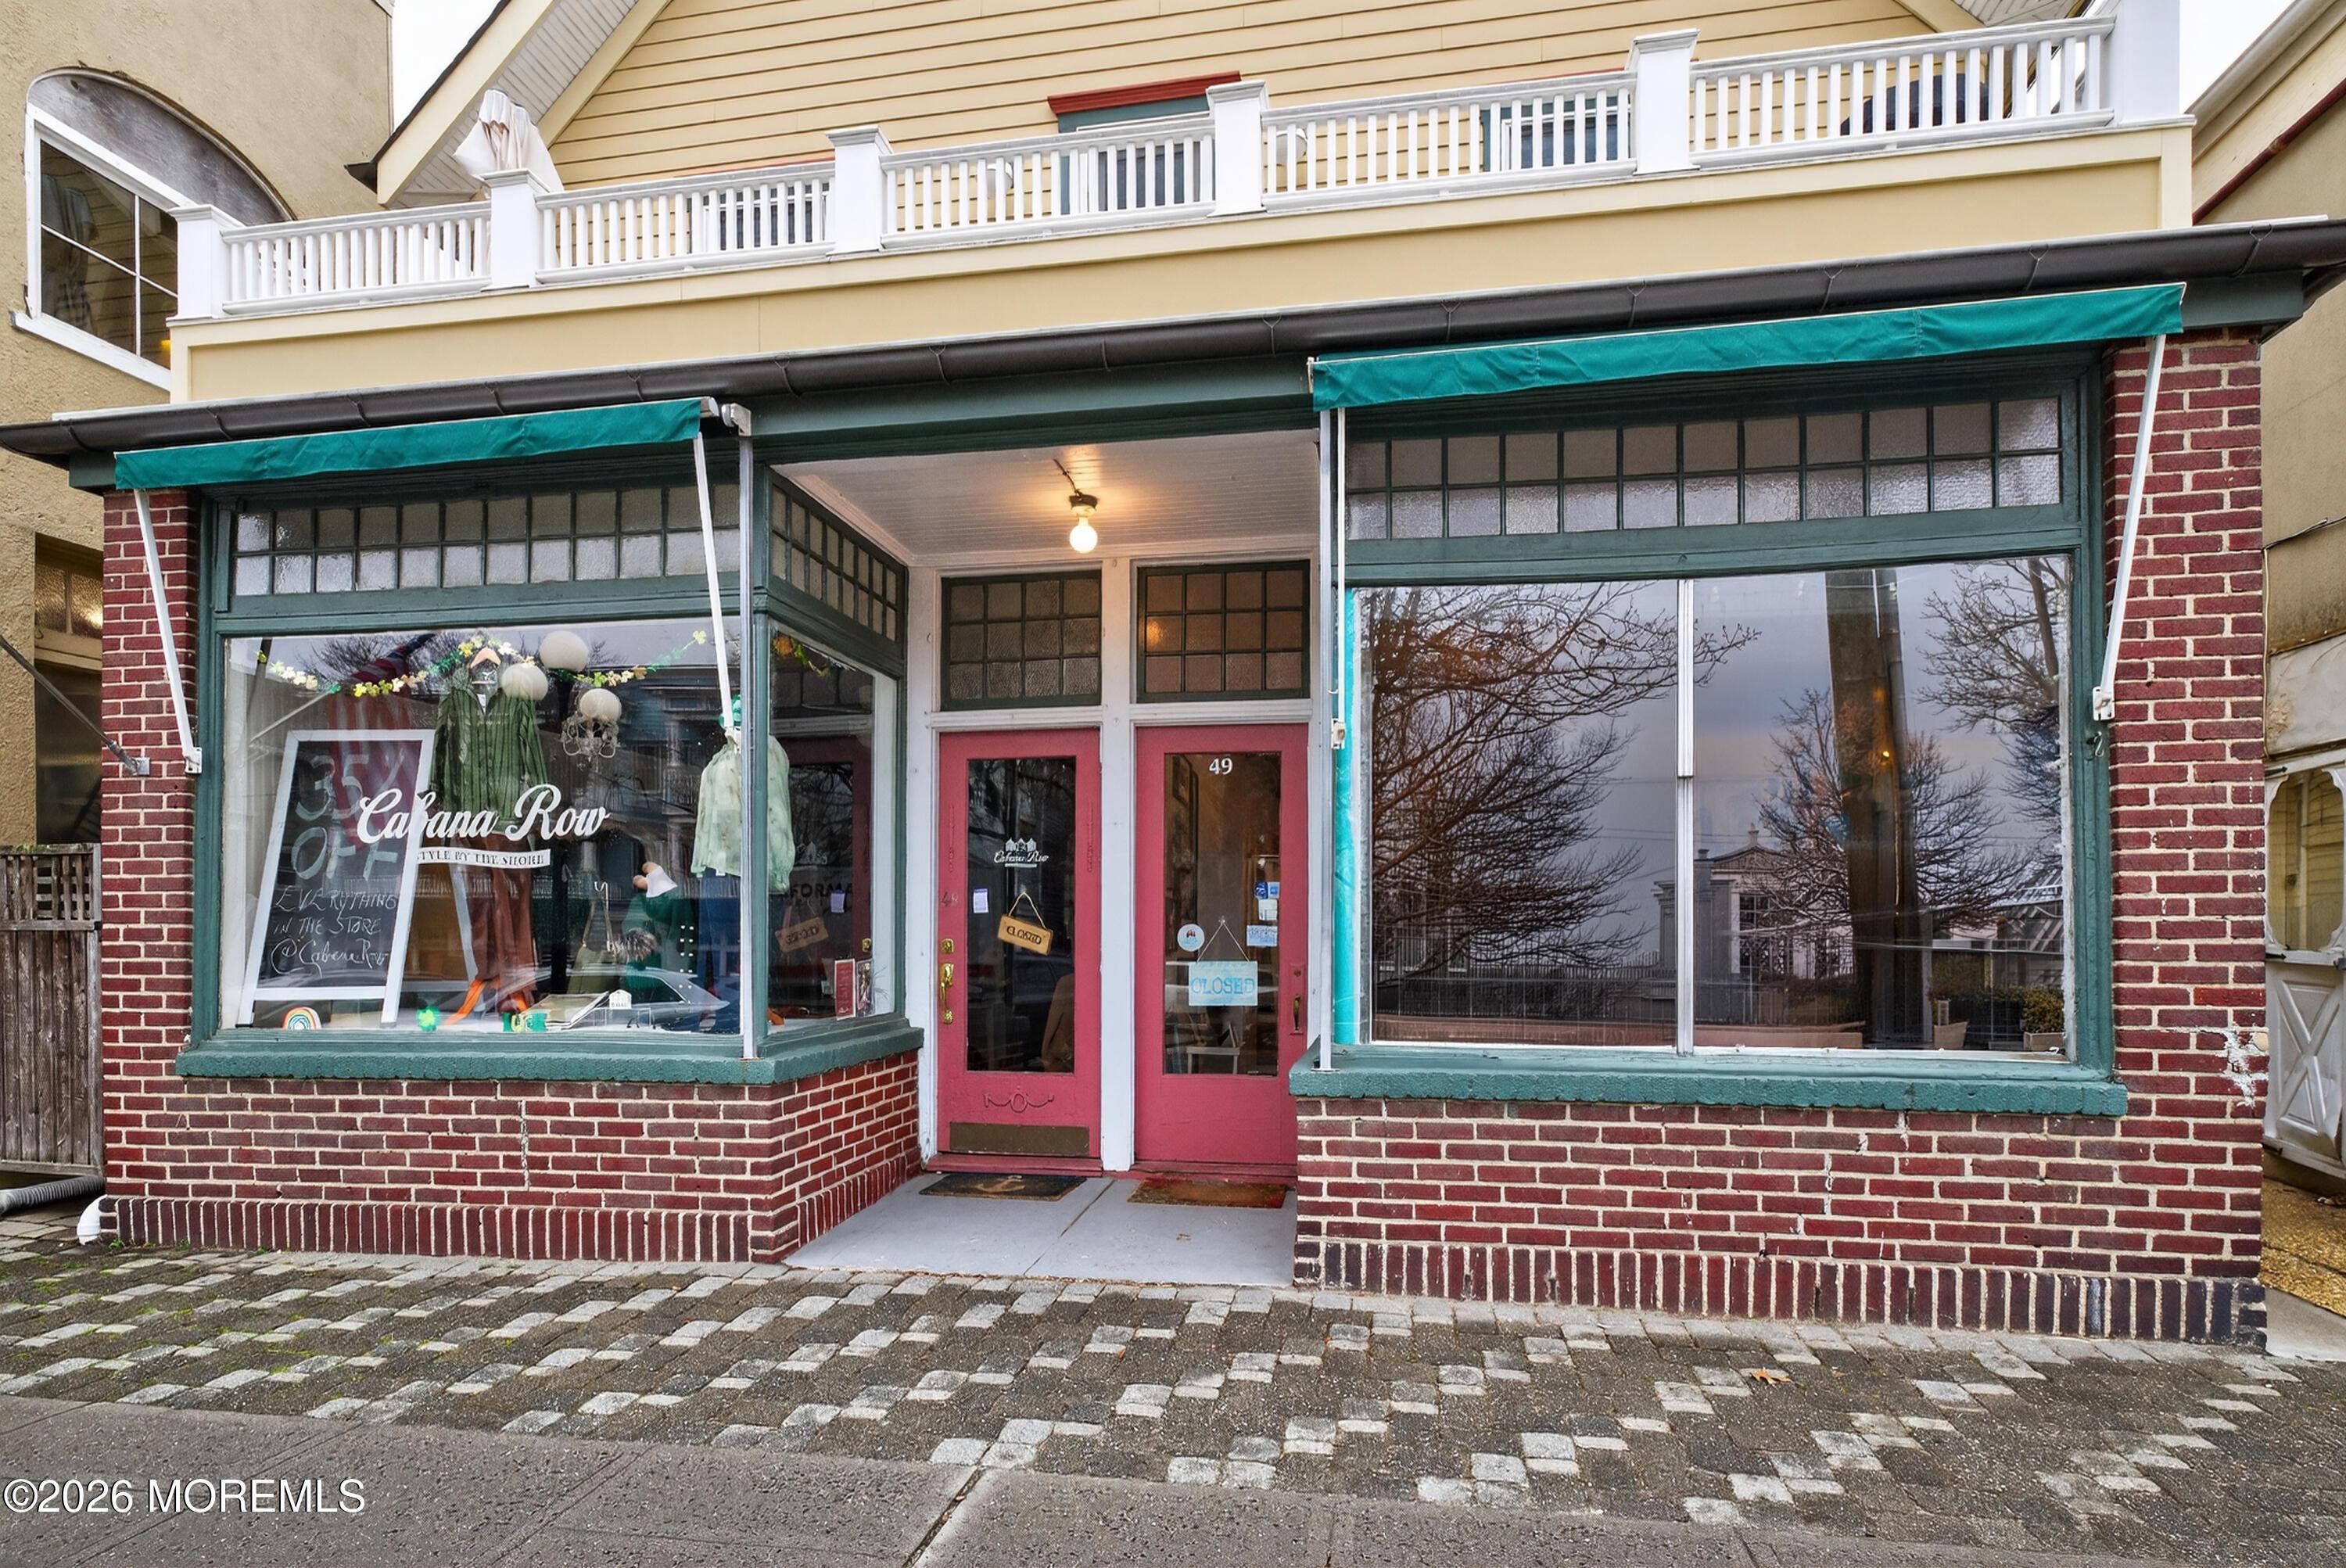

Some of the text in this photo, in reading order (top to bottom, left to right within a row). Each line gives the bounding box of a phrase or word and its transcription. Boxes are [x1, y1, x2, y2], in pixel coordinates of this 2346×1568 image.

[1209, 758, 1232, 775] 49
[357, 784, 611, 844] Cabana Row
[275, 885, 397, 917] EVERYTHING
[299, 917, 325, 935] THE
[328, 916, 382, 935] STORE
[1191, 977, 1255, 994] CLOSED
